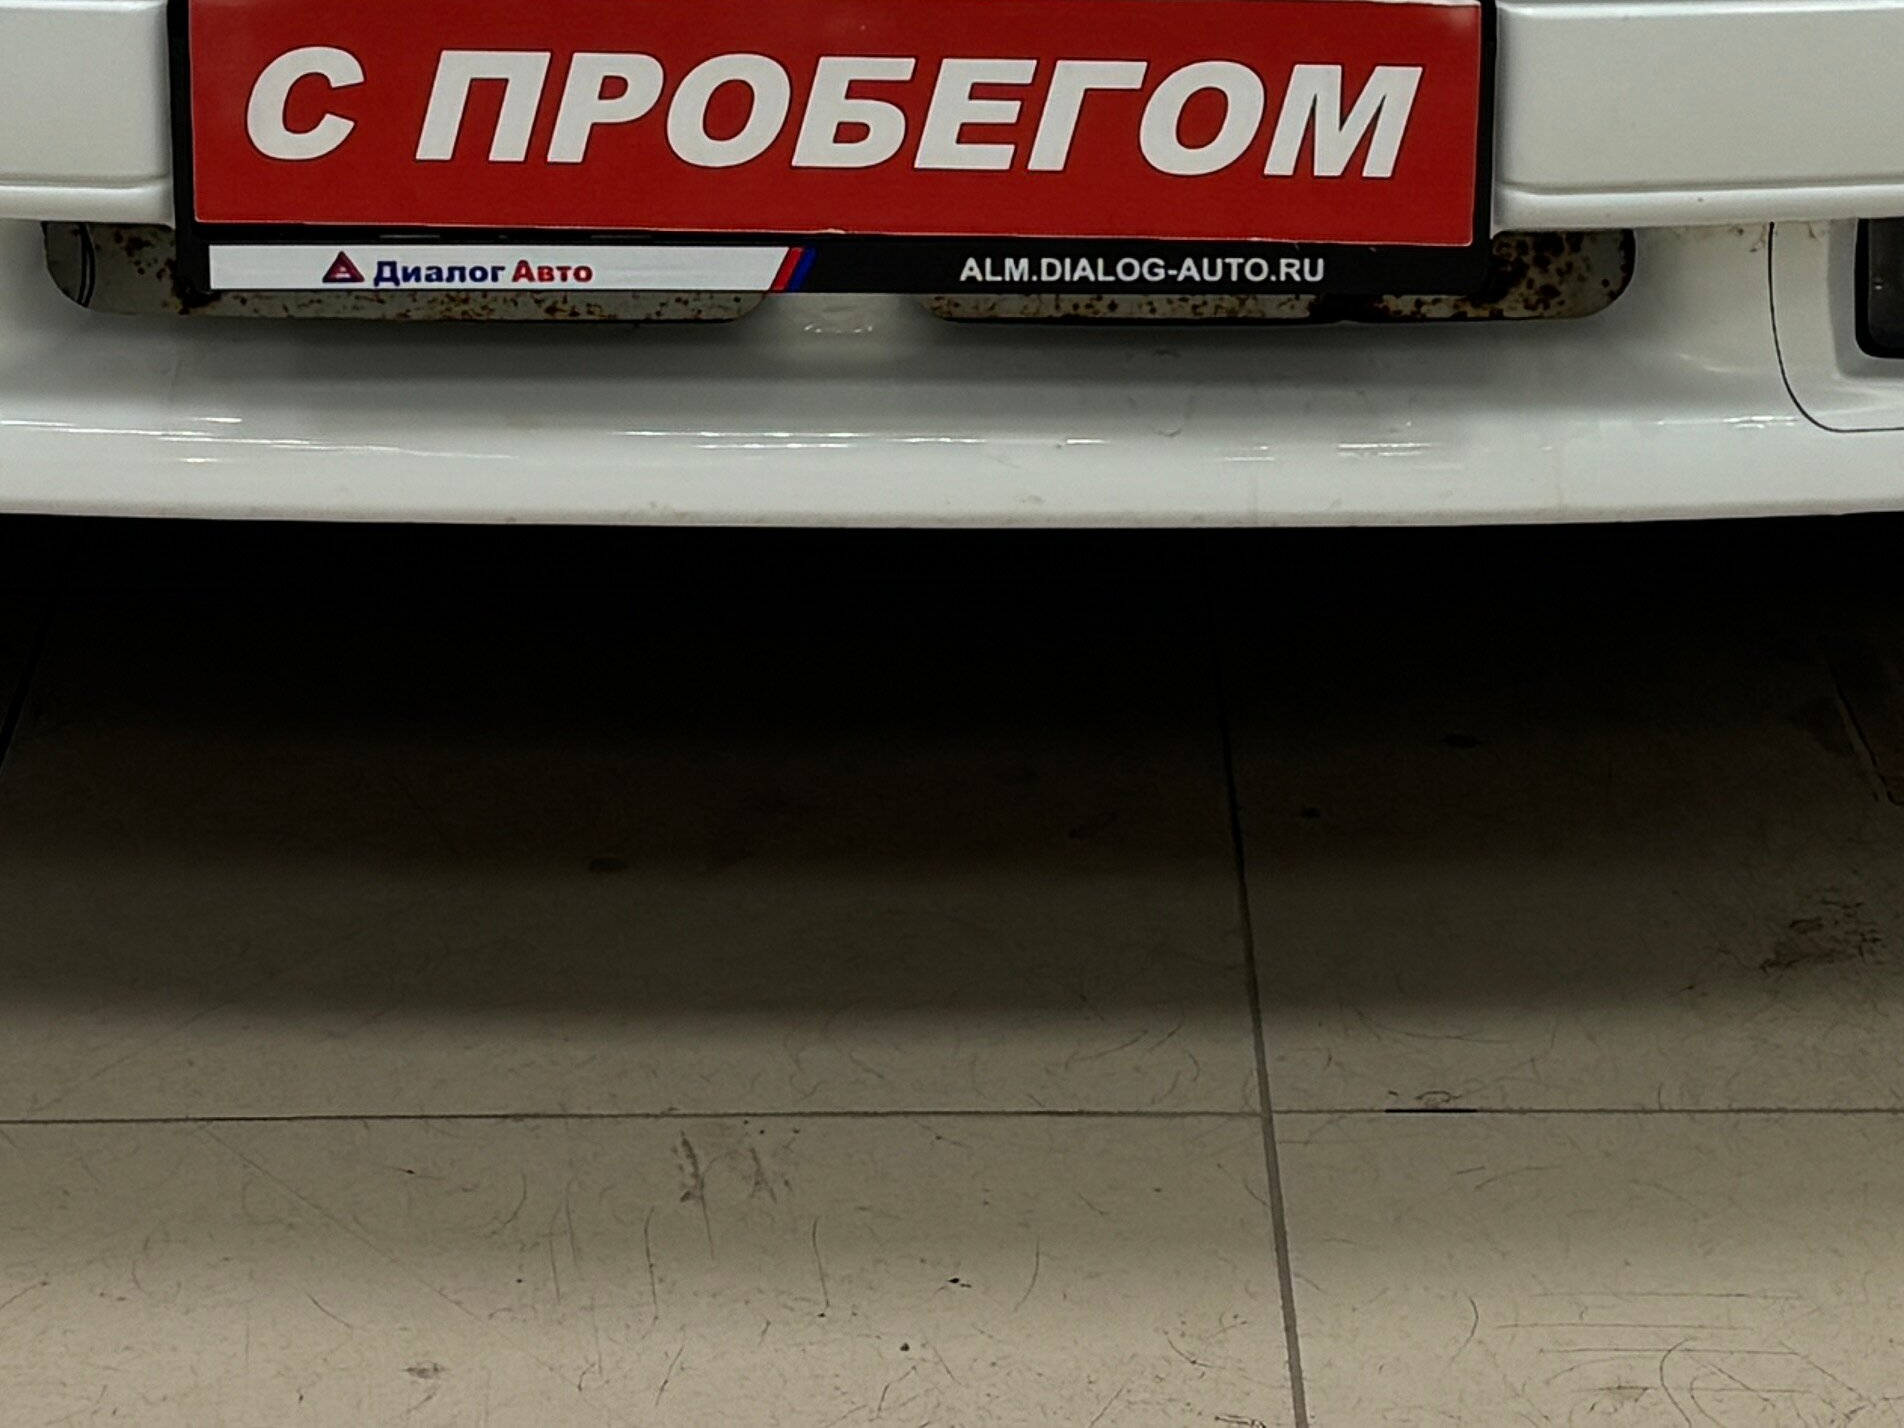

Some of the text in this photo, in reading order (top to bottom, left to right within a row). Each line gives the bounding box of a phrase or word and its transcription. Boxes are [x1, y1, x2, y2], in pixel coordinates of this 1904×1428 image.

[246, 47, 1423, 178] С ПРОБЕГОМ
[373, 259, 594, 287] Диалог Авто
[960, 257, 1325, 282] ALM.DIALOG-AUTO.RU
